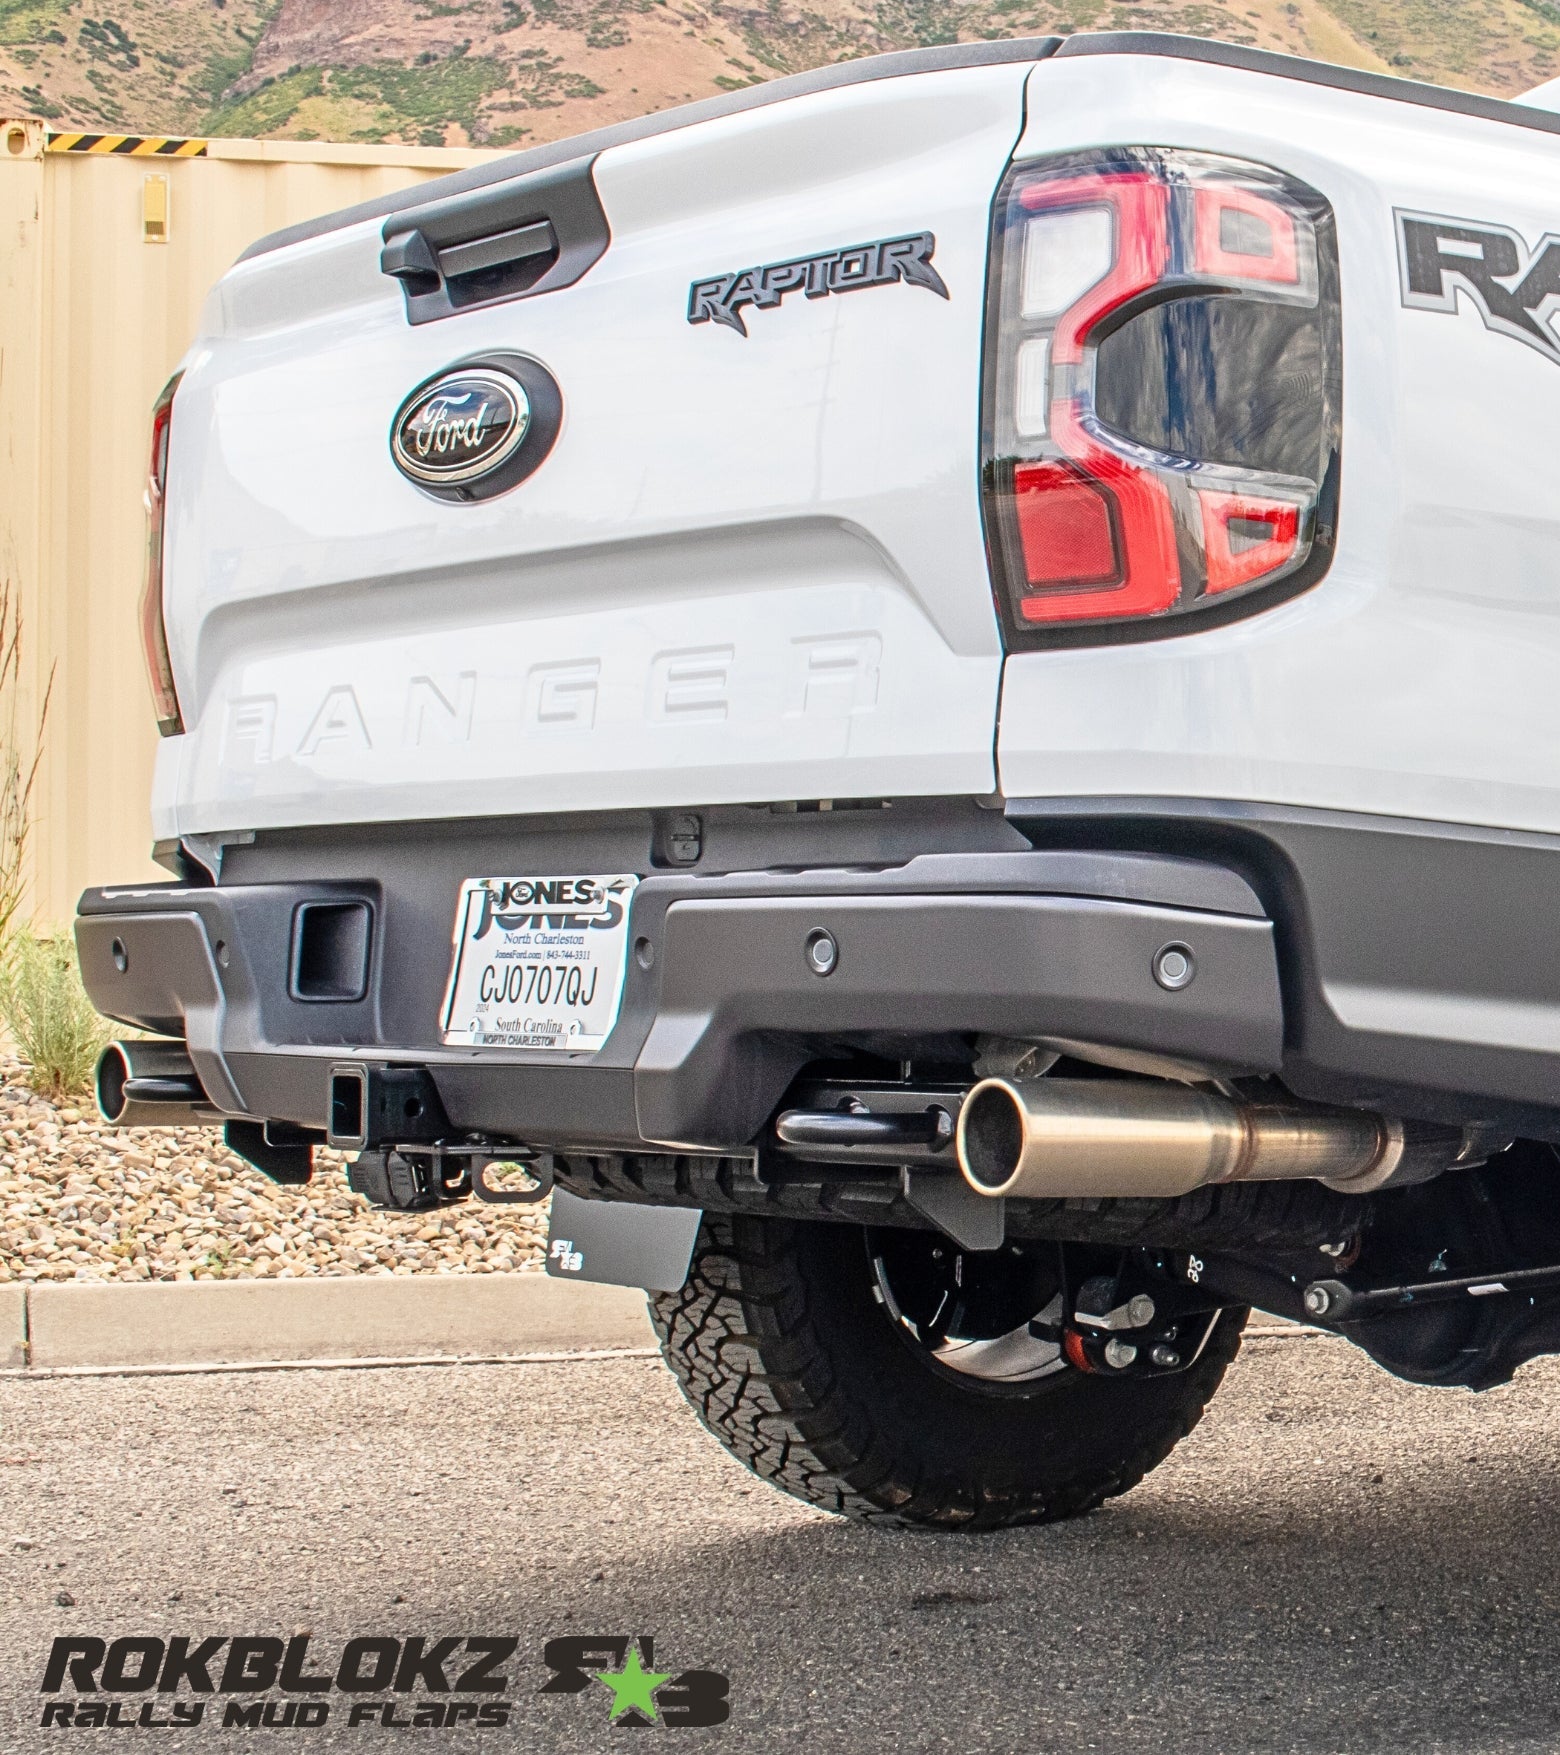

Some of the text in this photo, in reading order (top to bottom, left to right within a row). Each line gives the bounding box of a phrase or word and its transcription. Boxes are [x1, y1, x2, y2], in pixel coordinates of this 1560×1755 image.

[687, 230, 950, 338] RAPTOR
[407, 393, 492, 457] Ford
[218, 629, 883, 766] RANGER
[500, 879, 597, 910] JONES
[504, 932, 584, 945] North Charleston
[480, 965, 598, 1007] CJ0707QJ
[483, 1034, 557, 1047] NORTH CHARLESTON
[495, 1017, 563, 1033] South Carolina
